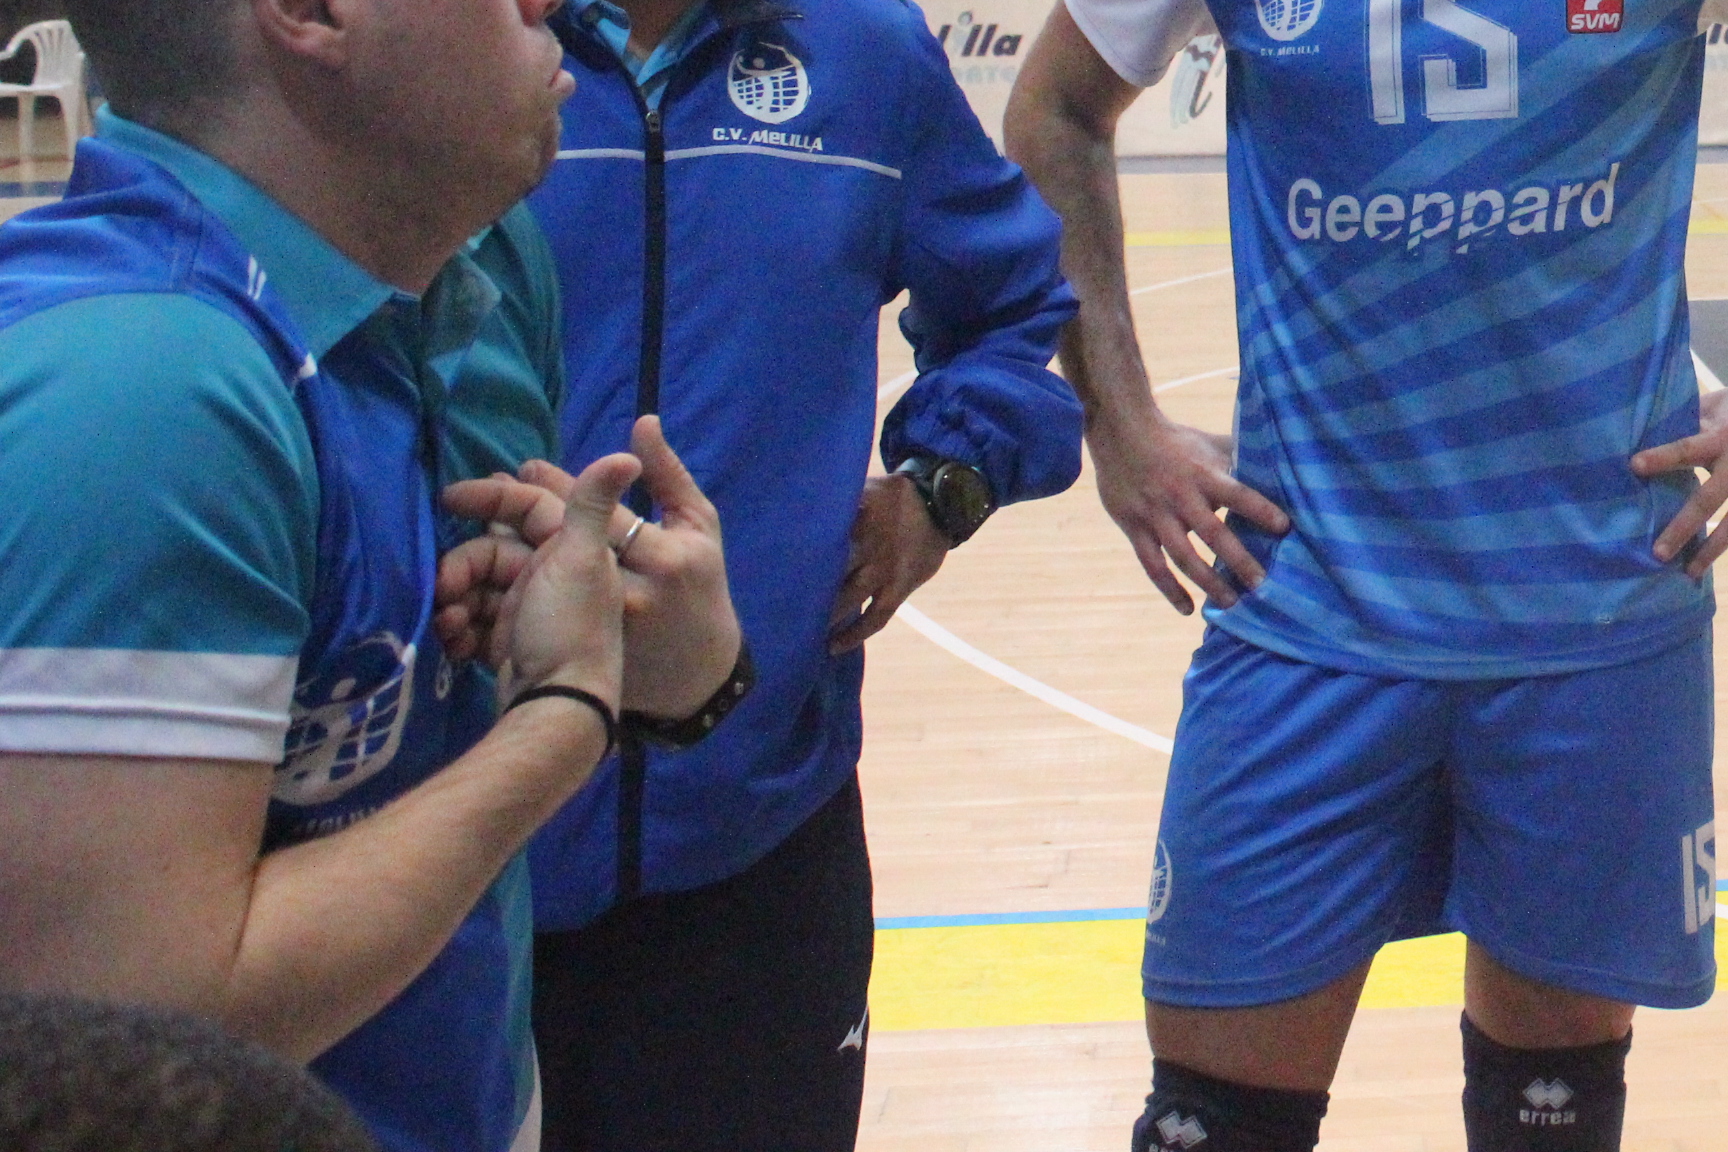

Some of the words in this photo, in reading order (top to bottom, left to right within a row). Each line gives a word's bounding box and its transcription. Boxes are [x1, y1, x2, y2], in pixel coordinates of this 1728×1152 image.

[1570, 11, 1620, 31] SVM
[713, 127, 747, 141] C.V.
[1287, 161, 1621, 255] Geeppard
